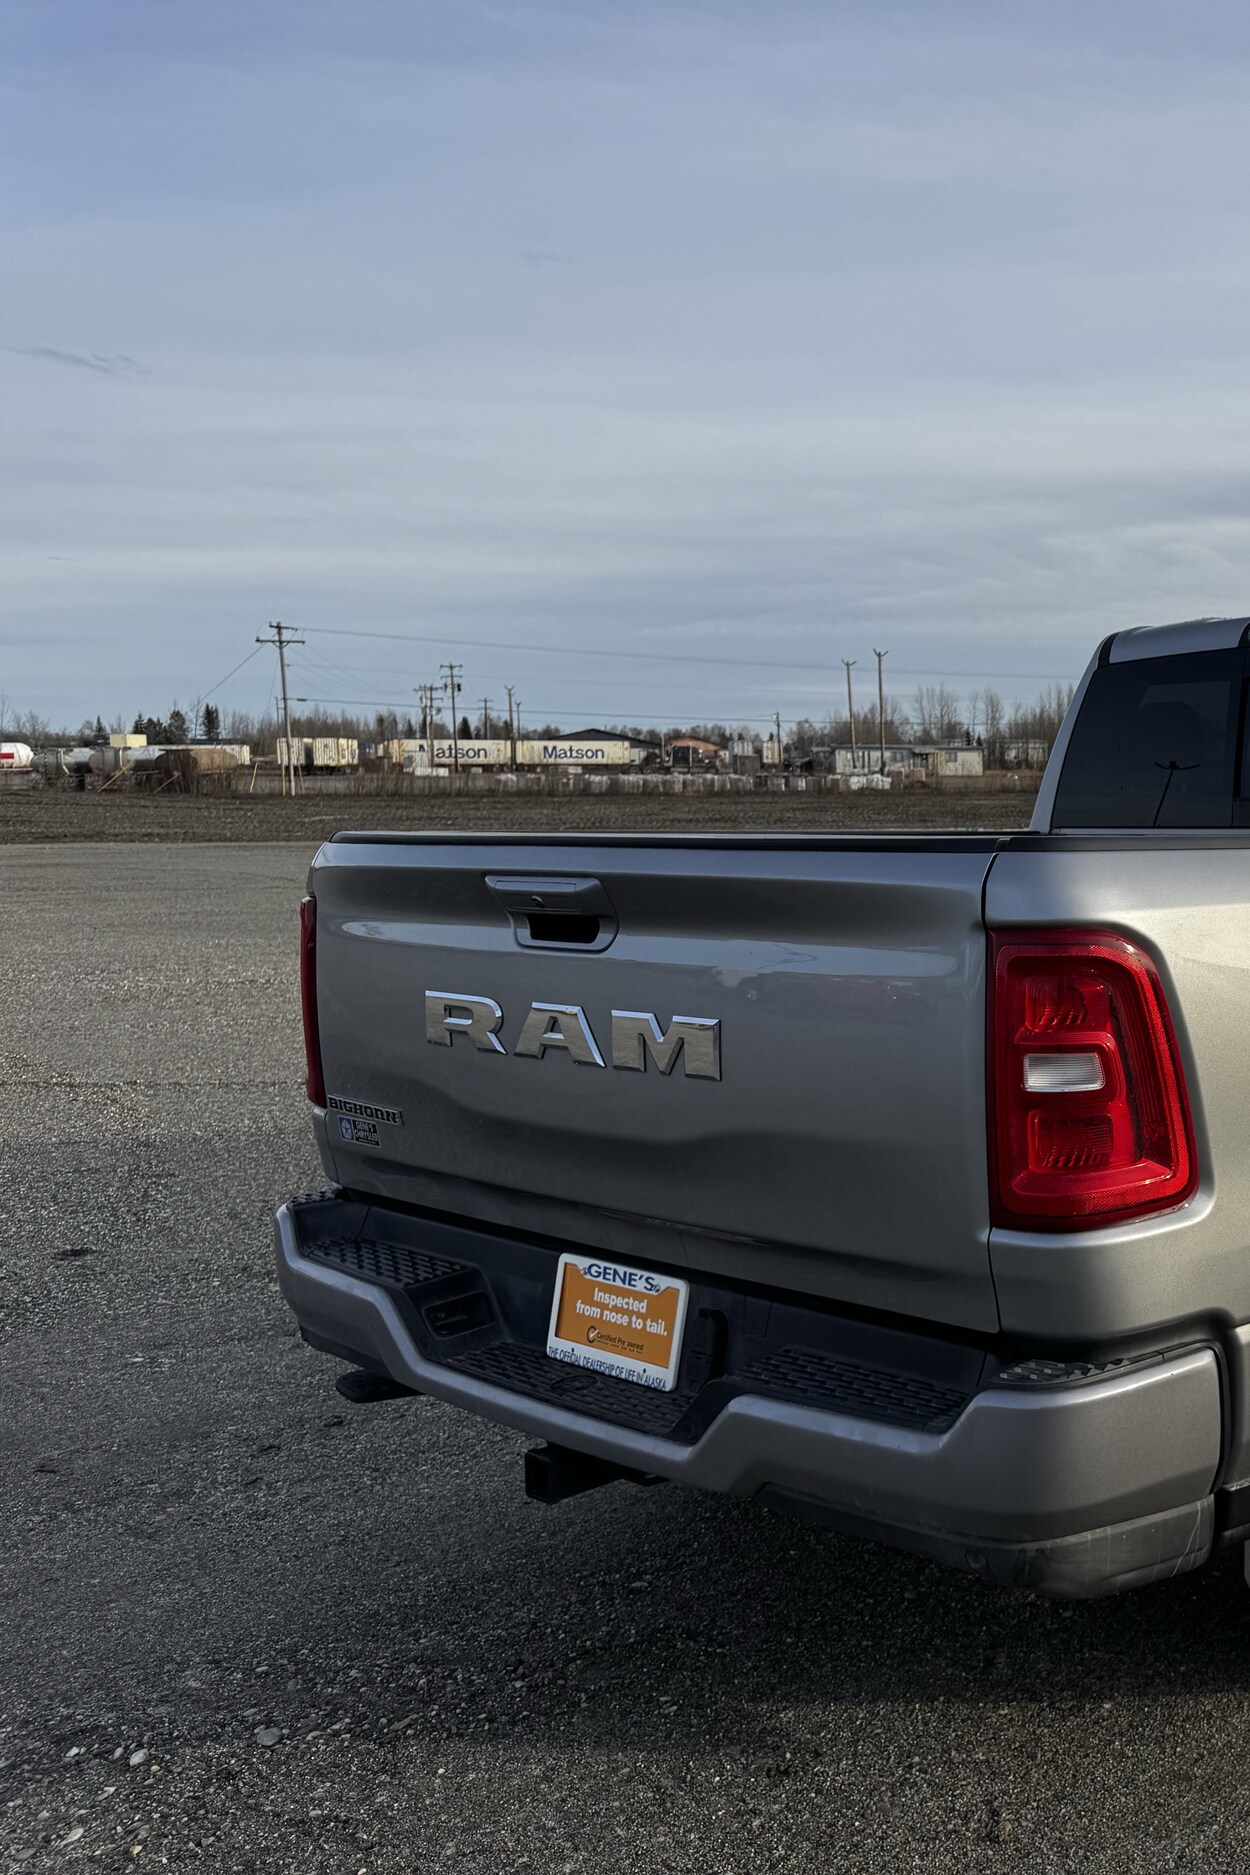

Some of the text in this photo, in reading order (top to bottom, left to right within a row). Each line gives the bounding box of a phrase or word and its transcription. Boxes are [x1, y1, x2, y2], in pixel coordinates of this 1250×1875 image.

[543, 744, 605, 759] Matson
[425, 990, 721, 1081] RAM
[328, 1096, 398, 1125] BIGHORN
[587, 1263, 655, 1291] GENE'S
[594, 1287, 647, 1313] Inspected
[576, 1300, 668, 1336] from nose to tail.
[597, 1332, 617, 1343] Certified
[548, 1346, 667, 1389] THE OFFICIAL DEALERSHIP OF LIFE IN ALASKA
